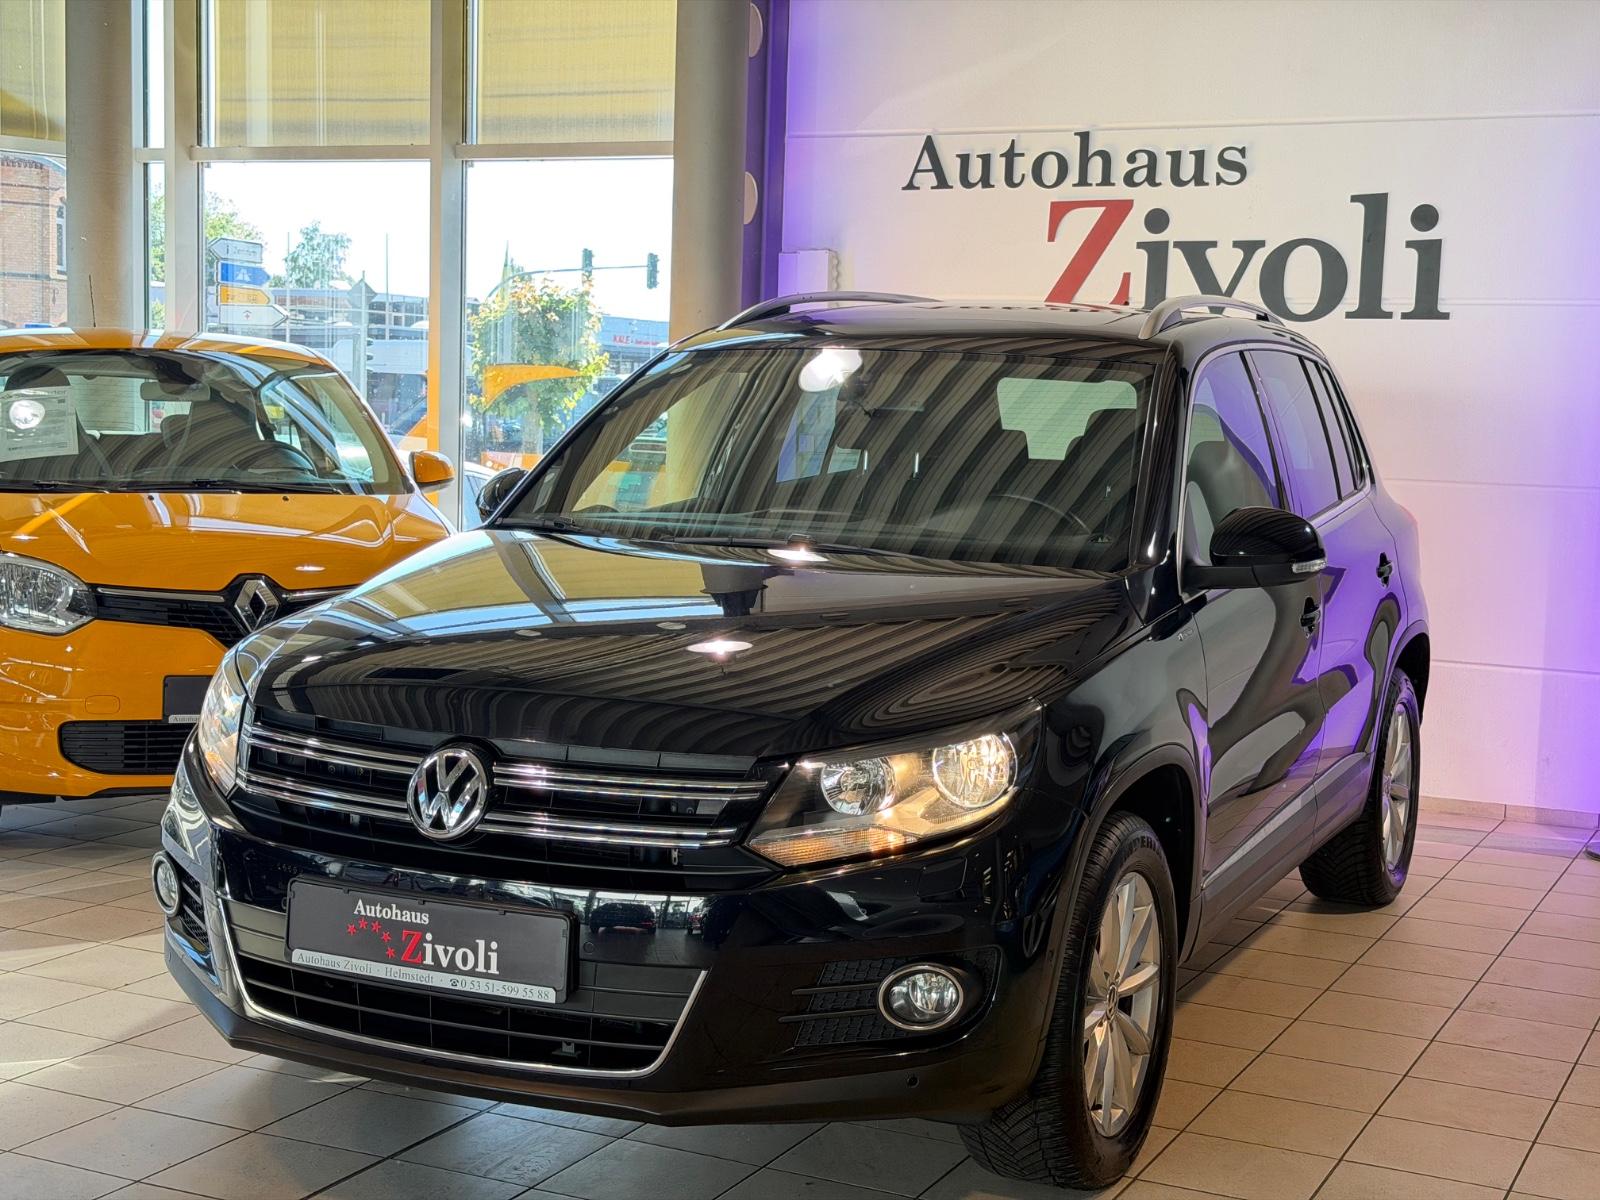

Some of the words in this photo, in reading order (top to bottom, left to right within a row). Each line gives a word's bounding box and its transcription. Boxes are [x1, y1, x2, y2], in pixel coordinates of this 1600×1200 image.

[902, 131, 1248, 191] Autohaus
[1045, 192, 1451, 321] Zivoli
[354, 898, 430, 925] Autohaus
[297, 952, 341, 968] Autohaus
[343, 959, 372, 974] Zivoli
[384, 967, 434, 984] Helmstedt
[401, 930, 499, 974] Zivoli
